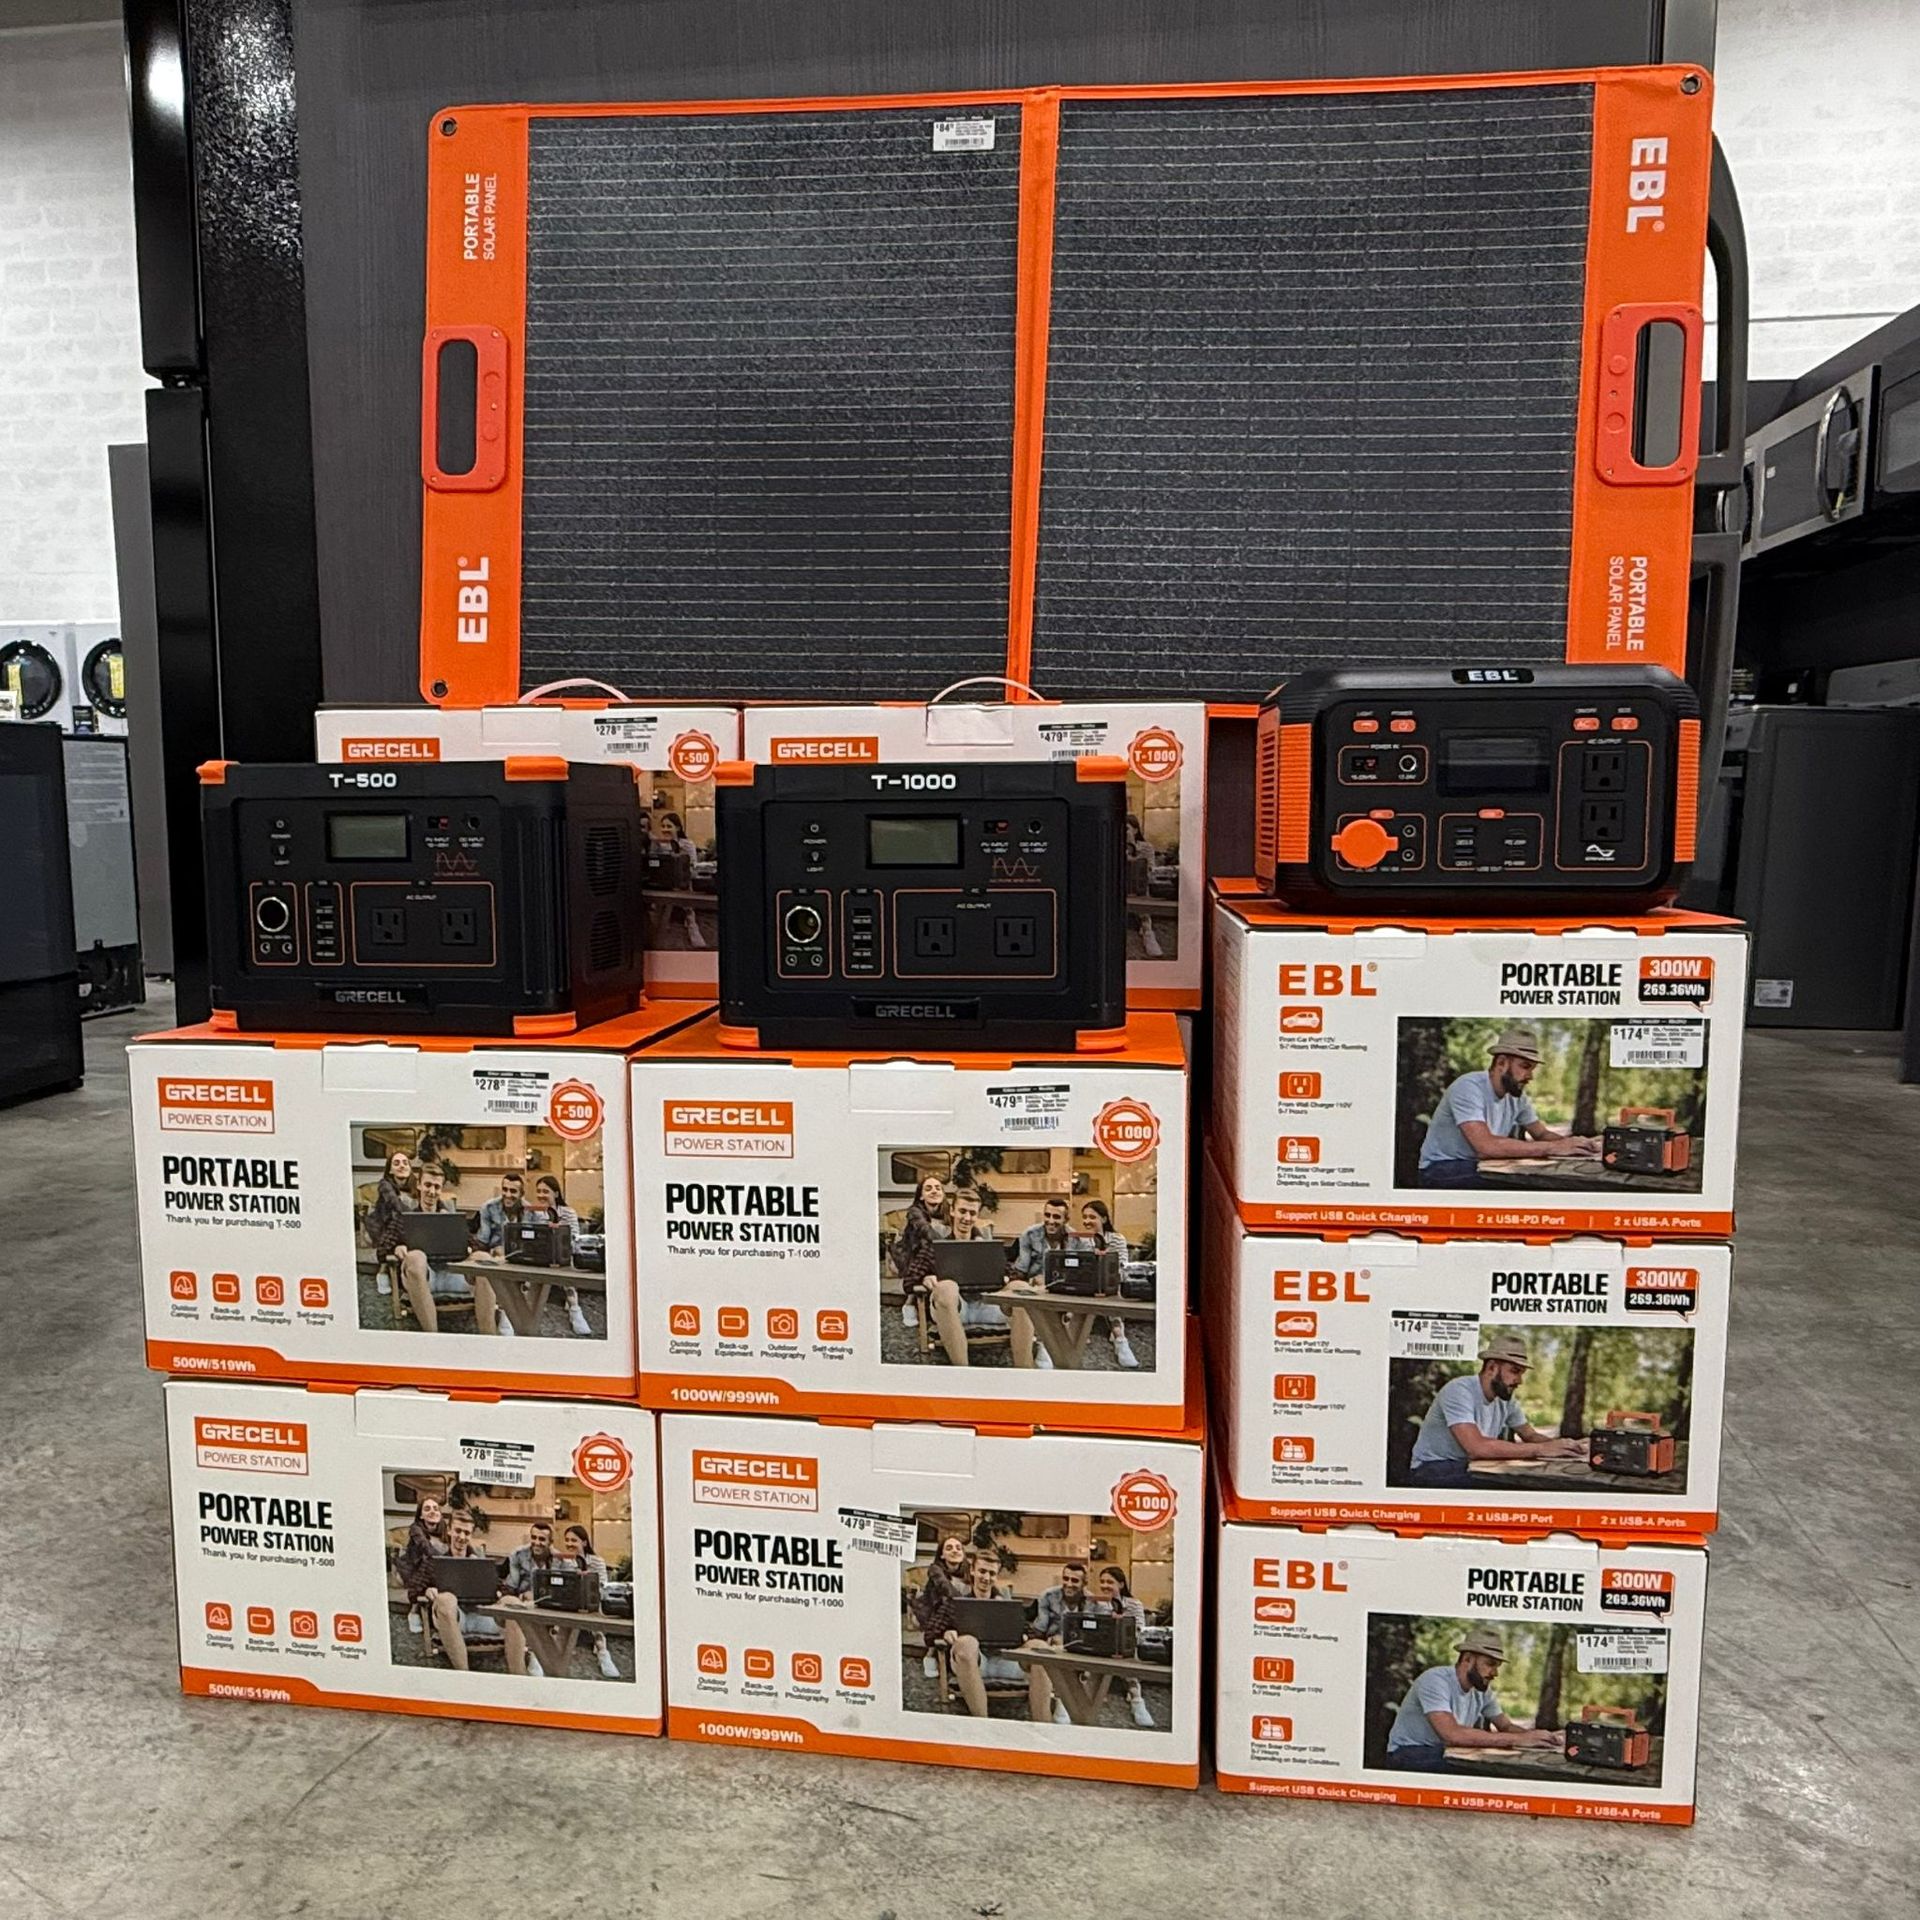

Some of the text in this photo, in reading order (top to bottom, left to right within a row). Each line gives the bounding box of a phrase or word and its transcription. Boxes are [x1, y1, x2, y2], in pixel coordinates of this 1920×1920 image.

[1626, 137, 1668, 232] EBL
[464, 173, 479, 260] PORTABLE
[483, 173, 497, 260] SOLAR PANEL
[457, 556, 488, 643] EBL
[1606, 556, 1624, 650] SOLAR PANEL
[1627, 557, 1648, 650] PORTABLE
[348, 743, 434, 758] GRECELL
[678, 752, 710, 764] T-500
[777, 742, 872, 758] GRECELL
[1134, 750, 1176, 762] T-1000
[329, 773, 397, 788] T-500
[871, 774, 957, 790] T-1000
[1501, 963, 1622, 987] PORTABLE
[1649, 960, 1702, 977] 300W
[335, 990, 406, 1003] GRECELL
[1500, 990, 1621, 1005] POWER STATION
[1643, 983, 1706, 997] 269.36Wh
[875, 1005, 956, 1018] GRECELL
[165, 1084, 267, 1103] GRECELL
[168, 1113, 267, 1127] POWER STATION
[555, 1104, 593, 1119] T-500
[672, 1107, 785, 1126] GRECELL
[1101, 1125, 1151, 1139] T-1000
[674, 1138, 785, 1151] POWER STATION
[162, 1156, 299, 1189] PORTABLE
[164, 1191, 300, 1214] POWER STATION
[666, 1183, 819, 1217] PORTABLE
[166, 1214, 301, 1229] Thank you for purchasing T-500
[1275, 1210, 1429, 1224] Support USB Quick Charging
[1477, 1214, 1484, 1223] 2
[1496, 1214, 1539, 1225] USB-PD
[1541, 1215, 1565, 1225] Port
[1614, 1216, 1621, 1226] 2
[1632, 1216, 1669, 1227] USB-A
[1671, 1217, 1702, 1227] Ports
[666, 1220, 820, 1243] POWER STATION
[667, 1245, 820, 1259] Thank you for purchasing T-1000
[1491, 1272, 1609, 1295] PORTABLE
[1636, 1270, 1687, 1287] 300W
[1490, 1298, 1607, 1313] POWER STATION
[1629, 1293, 1690, 1306] 269.36Wh
[172, 1356, 256, 1372] 500W/519Wh
[671, 1388, 779, 1404] 1000W/999Wh
[202, 1423, 300, 1446] GRECELL
[204, 1451, 301, 1468] POWER STATION
[583, 1457, 620, 1471] T-500
[701, 1456, 810, 1481] GRECELL
[702, 1486, 809, 1504] POWER STATION
[1120, 1494, 1169, 1510] T-1000
[199, 1492, 333, 1529] PORTABLE
[1270, 1506, 1420, 1521] Support USB Quick Charging
[1467, 1512, 1474, 1521] 2
[1486, 1513, 1528, 1522] USB-PD
[1530, 1513, 1552, 1523] Port
[1601, 1516, 1608, 1525] 2
[1619, 1516, 1655, 1526] USB-A
[1657, 1517, 1687, 1527] Ports
[200, 1525, 334, 1553] POWER STATION
[694, 1528, 843, 1568] PORTABLE
[202, 1548, 335, 1567] Thank you for purchasing T-500
[695, 1564, 843, 1593] POWER STATION
[1468, 1568, 1585, 1594] PORTABLE
[1611, 1571, 1663, 1589] 300W
[696, 1588, 844, 1607] Thank you for purchasing T-1000
[1467, 1593, 1584, 1612] POWER STATION
[1605, 1593, 1665, 1608] 269.36Wh
[209, 1683, 290, 1701] 500W/519Wh
[698, 1722, 804, 1743] 1000W/999Wh
[1249, 1781, 1397, 1802] Support USB Quick Charging
[1443, 1795, 1450, 1805] 2
[1461, 1797, 1504, 1808] USB-PD
[1506, 1800, 1529, 1810] Port
[1575, 1804, 1583, 1814] 2
[1594, 1806, 1630, 1817] USB-A
[1632, 1809, 1661, 1819] Ports
